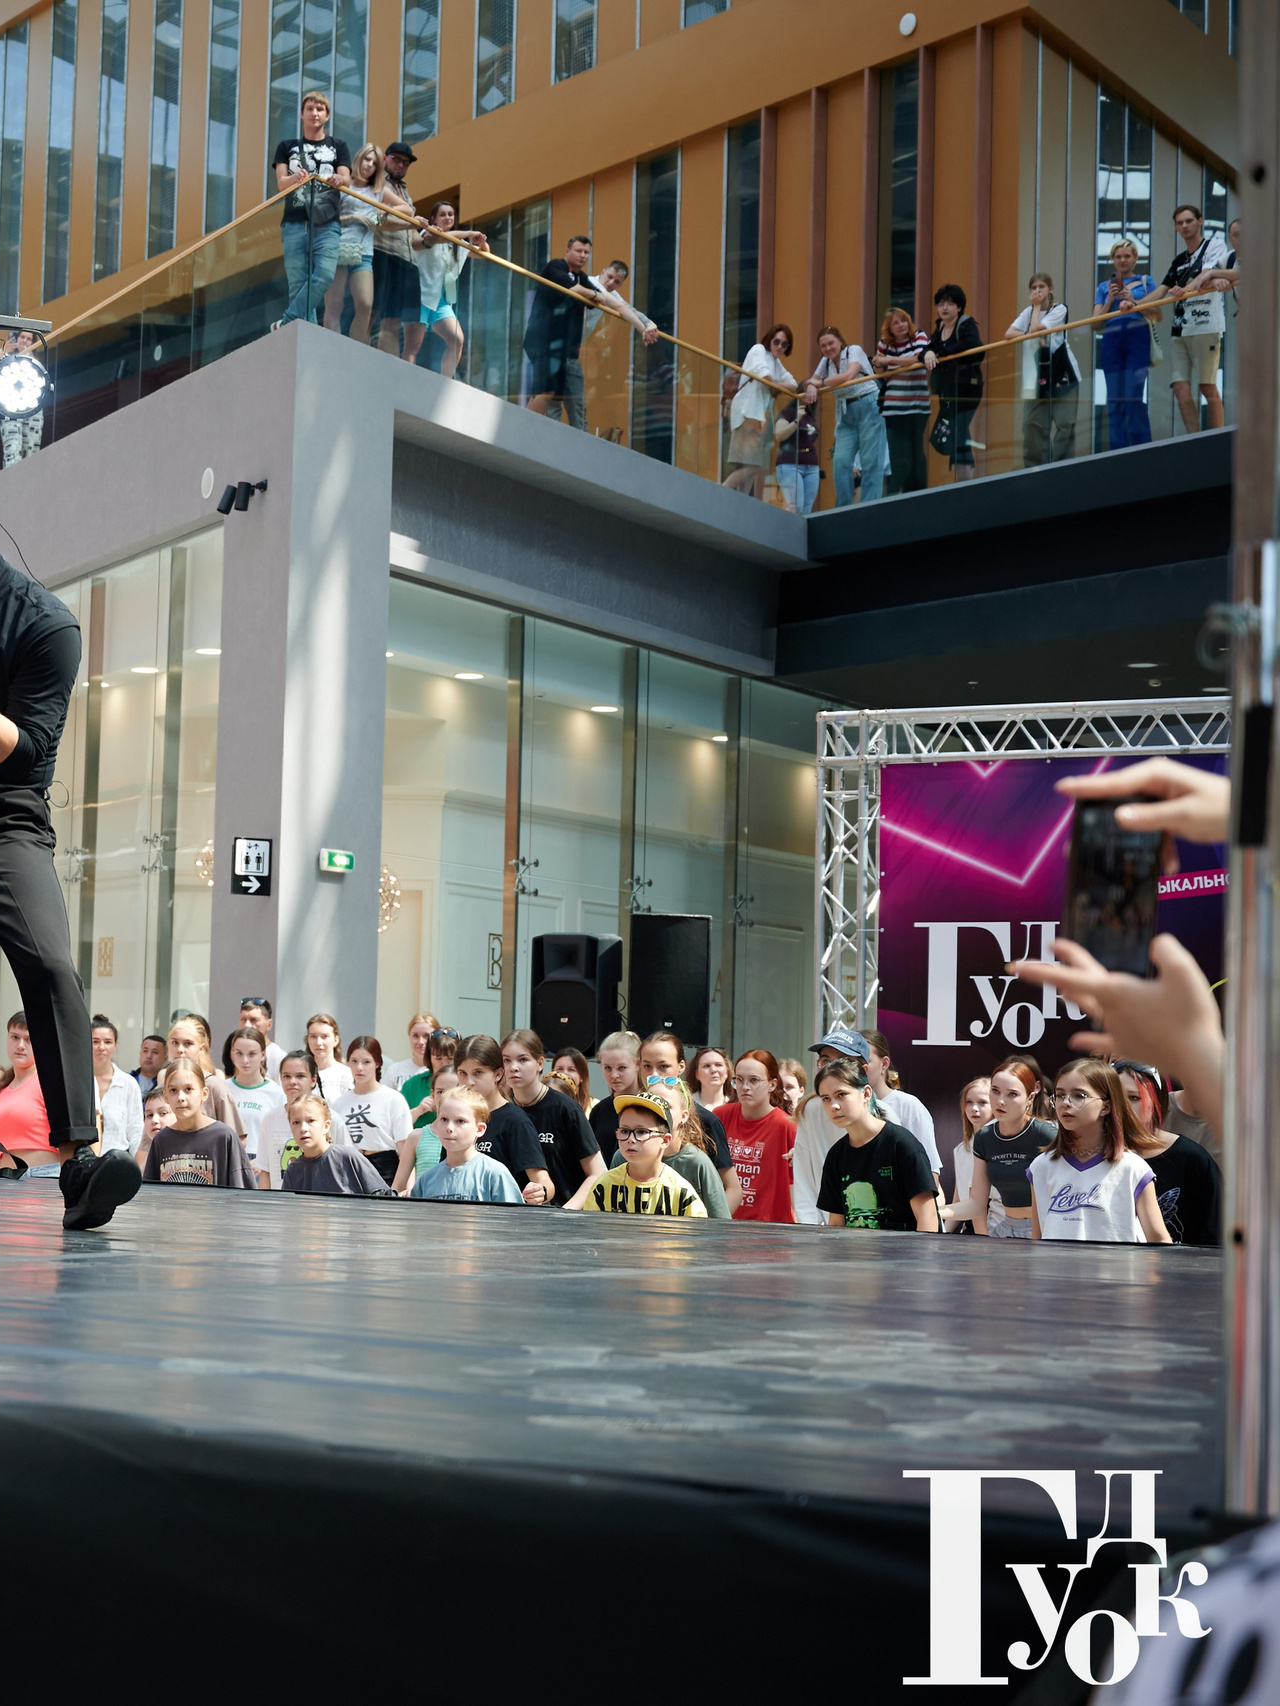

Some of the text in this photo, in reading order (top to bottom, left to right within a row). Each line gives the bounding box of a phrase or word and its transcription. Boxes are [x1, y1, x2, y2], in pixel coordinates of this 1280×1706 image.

[243, 1101, 263, 1111] YORK
[733, 1162, 761, 1175] man
[1047, 1183, 1105, 1214] Level
